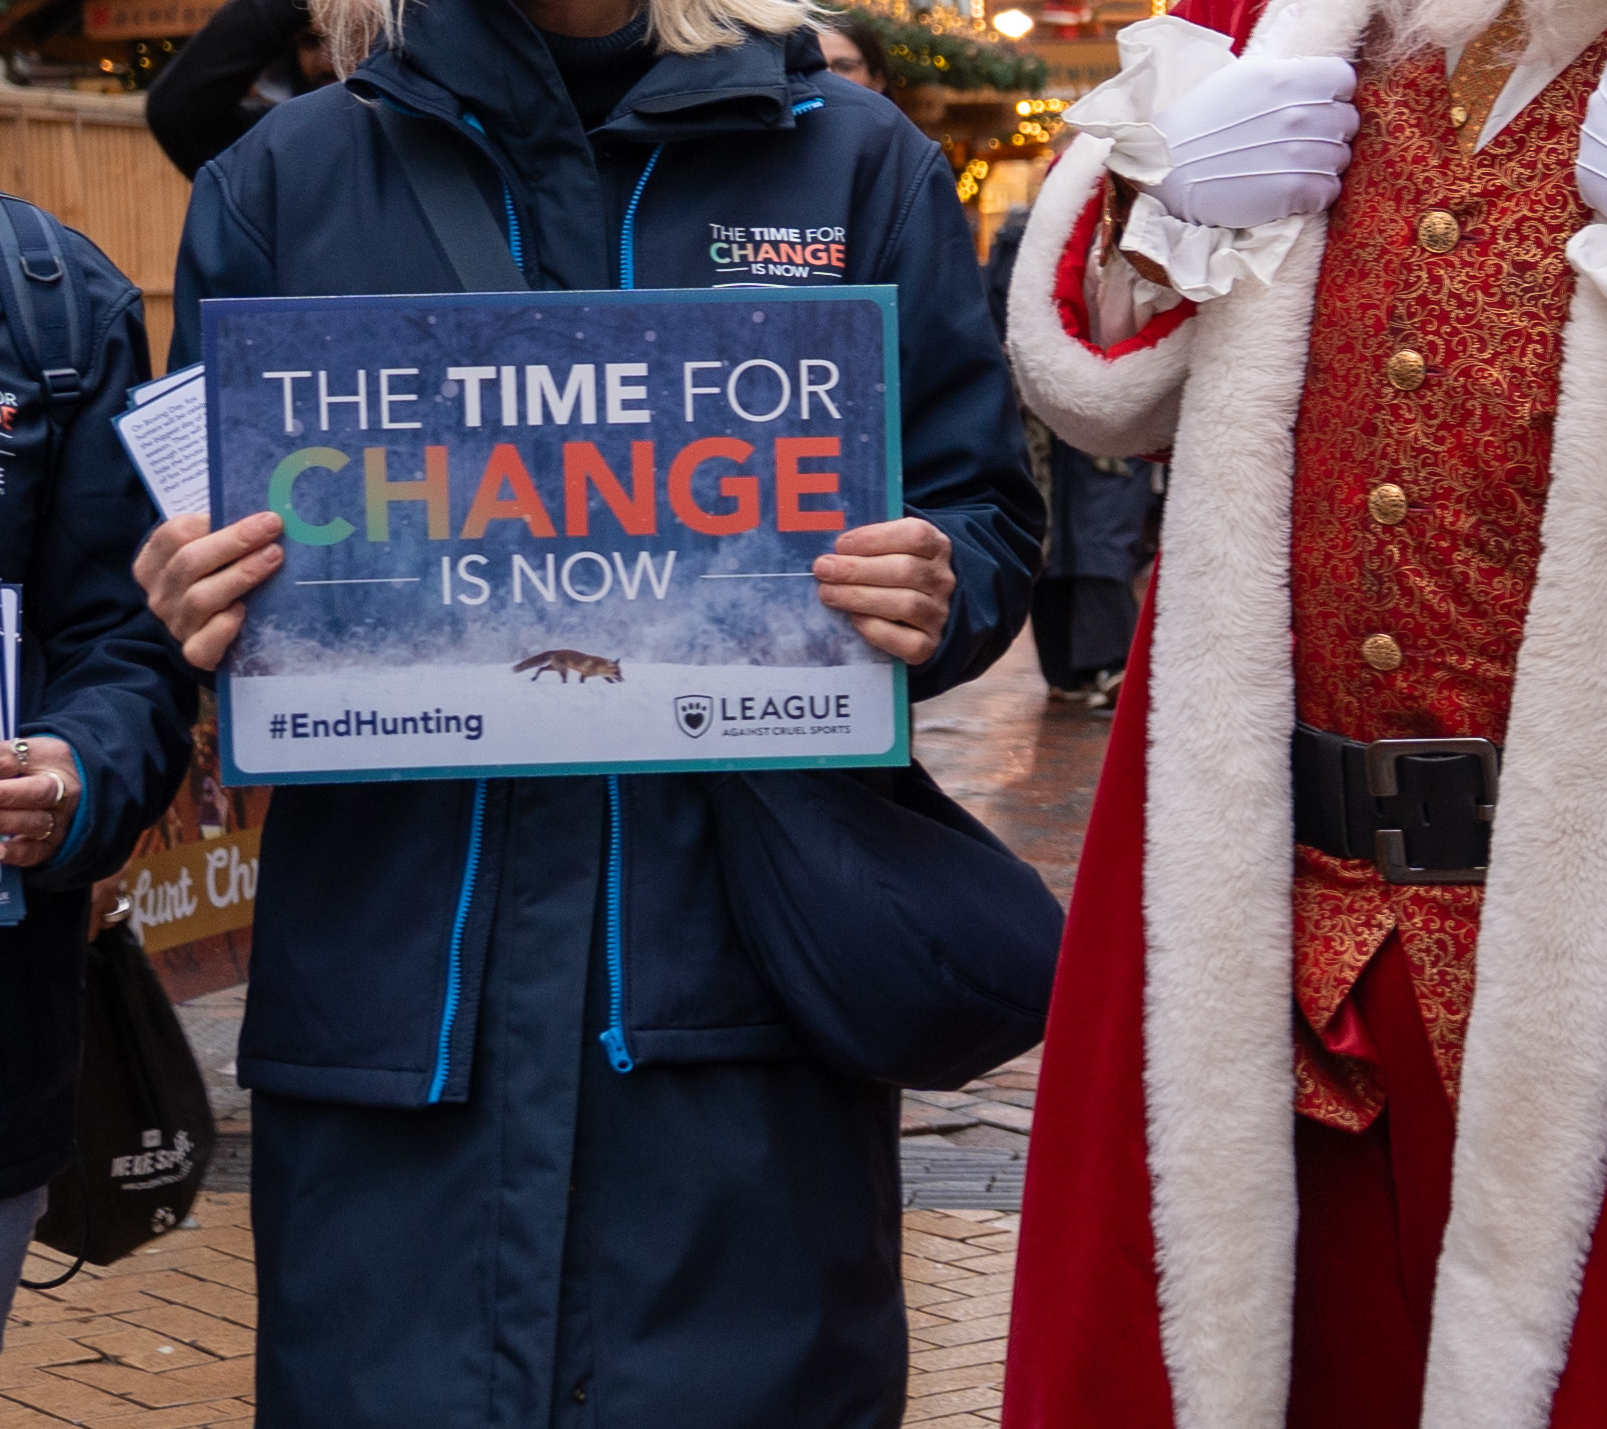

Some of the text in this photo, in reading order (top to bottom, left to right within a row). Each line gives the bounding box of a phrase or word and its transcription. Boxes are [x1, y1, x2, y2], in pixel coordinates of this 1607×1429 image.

[708, 223, 846, 243] THE TIME FOR
[709, 241, 846, 268] CHANGE
[751, 262, 810, 278] IS NOW
[263, 357, 842, 433] THE TIME FOR
[267, 435, 846, 546] CHANGE
[441, 549, 677, 606] IS NOW
[721, 694, 851, 721] LEAGUE
[269, 707, 484, 744] #EndHunting
[722, 724, 851, 737] AGAINST CRUEL SPORTS
